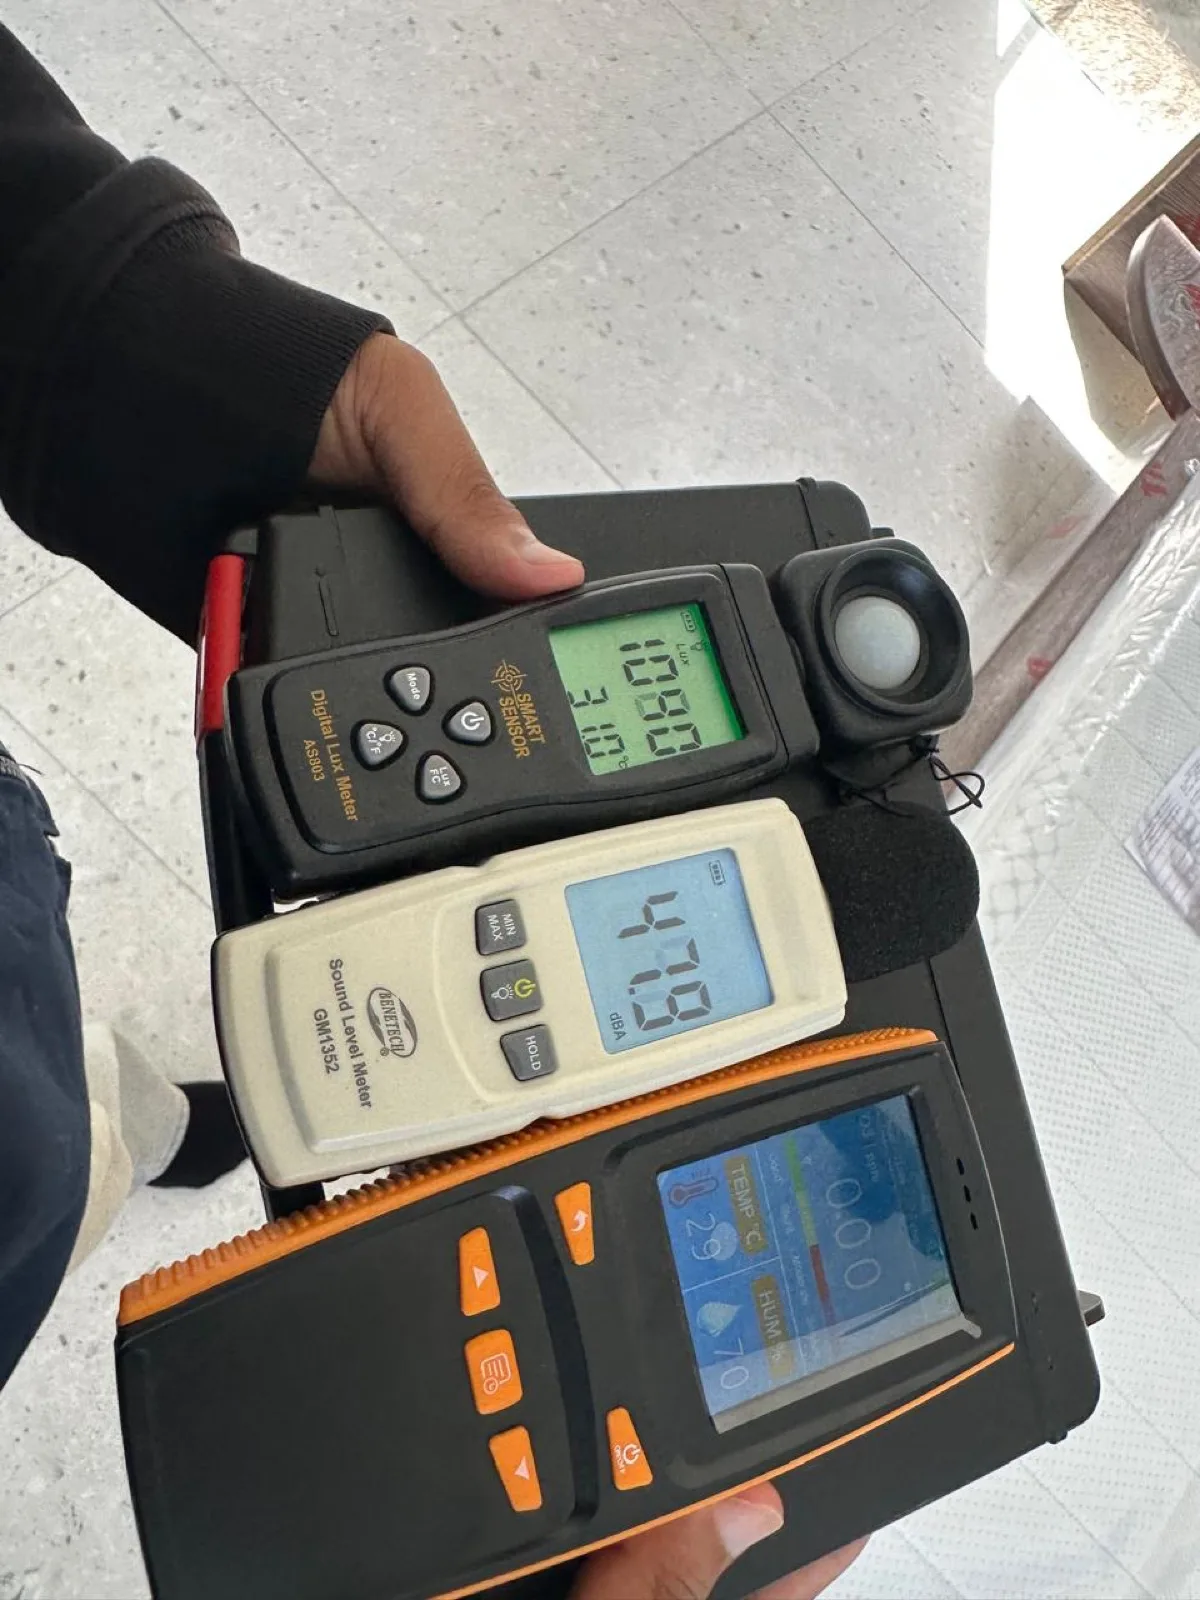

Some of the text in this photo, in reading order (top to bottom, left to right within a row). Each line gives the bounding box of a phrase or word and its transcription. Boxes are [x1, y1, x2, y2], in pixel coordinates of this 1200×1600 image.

[676, 643, 690, 666] Lux
[406, 673, 421, 700] Mode
[499, 697, 531, 760] SENSOR
[516, 693, 546, 744] SMART
[303, 739, 326, 781] AS803
[310, 689, 358, 821] Digital Lux Meter
[439, 766, 451, 786] Lux
[429, 769, 441, 785] FC
[486, 914, 504, 942] MAX
[502, 913, 517, 936] MIN
[313, 1008, 341, 1075] GM1352
[329, 958, 373, 1109] Sound Level Meter
[378, 991, 406, 1052] BENETECH
[609, 1012, 628, 1041] dBA
[525, 1035, 542, 1071] HOLD
[731, 1163, 756, 1218] TEMP
[685, 1213, 721, 1262] 29
